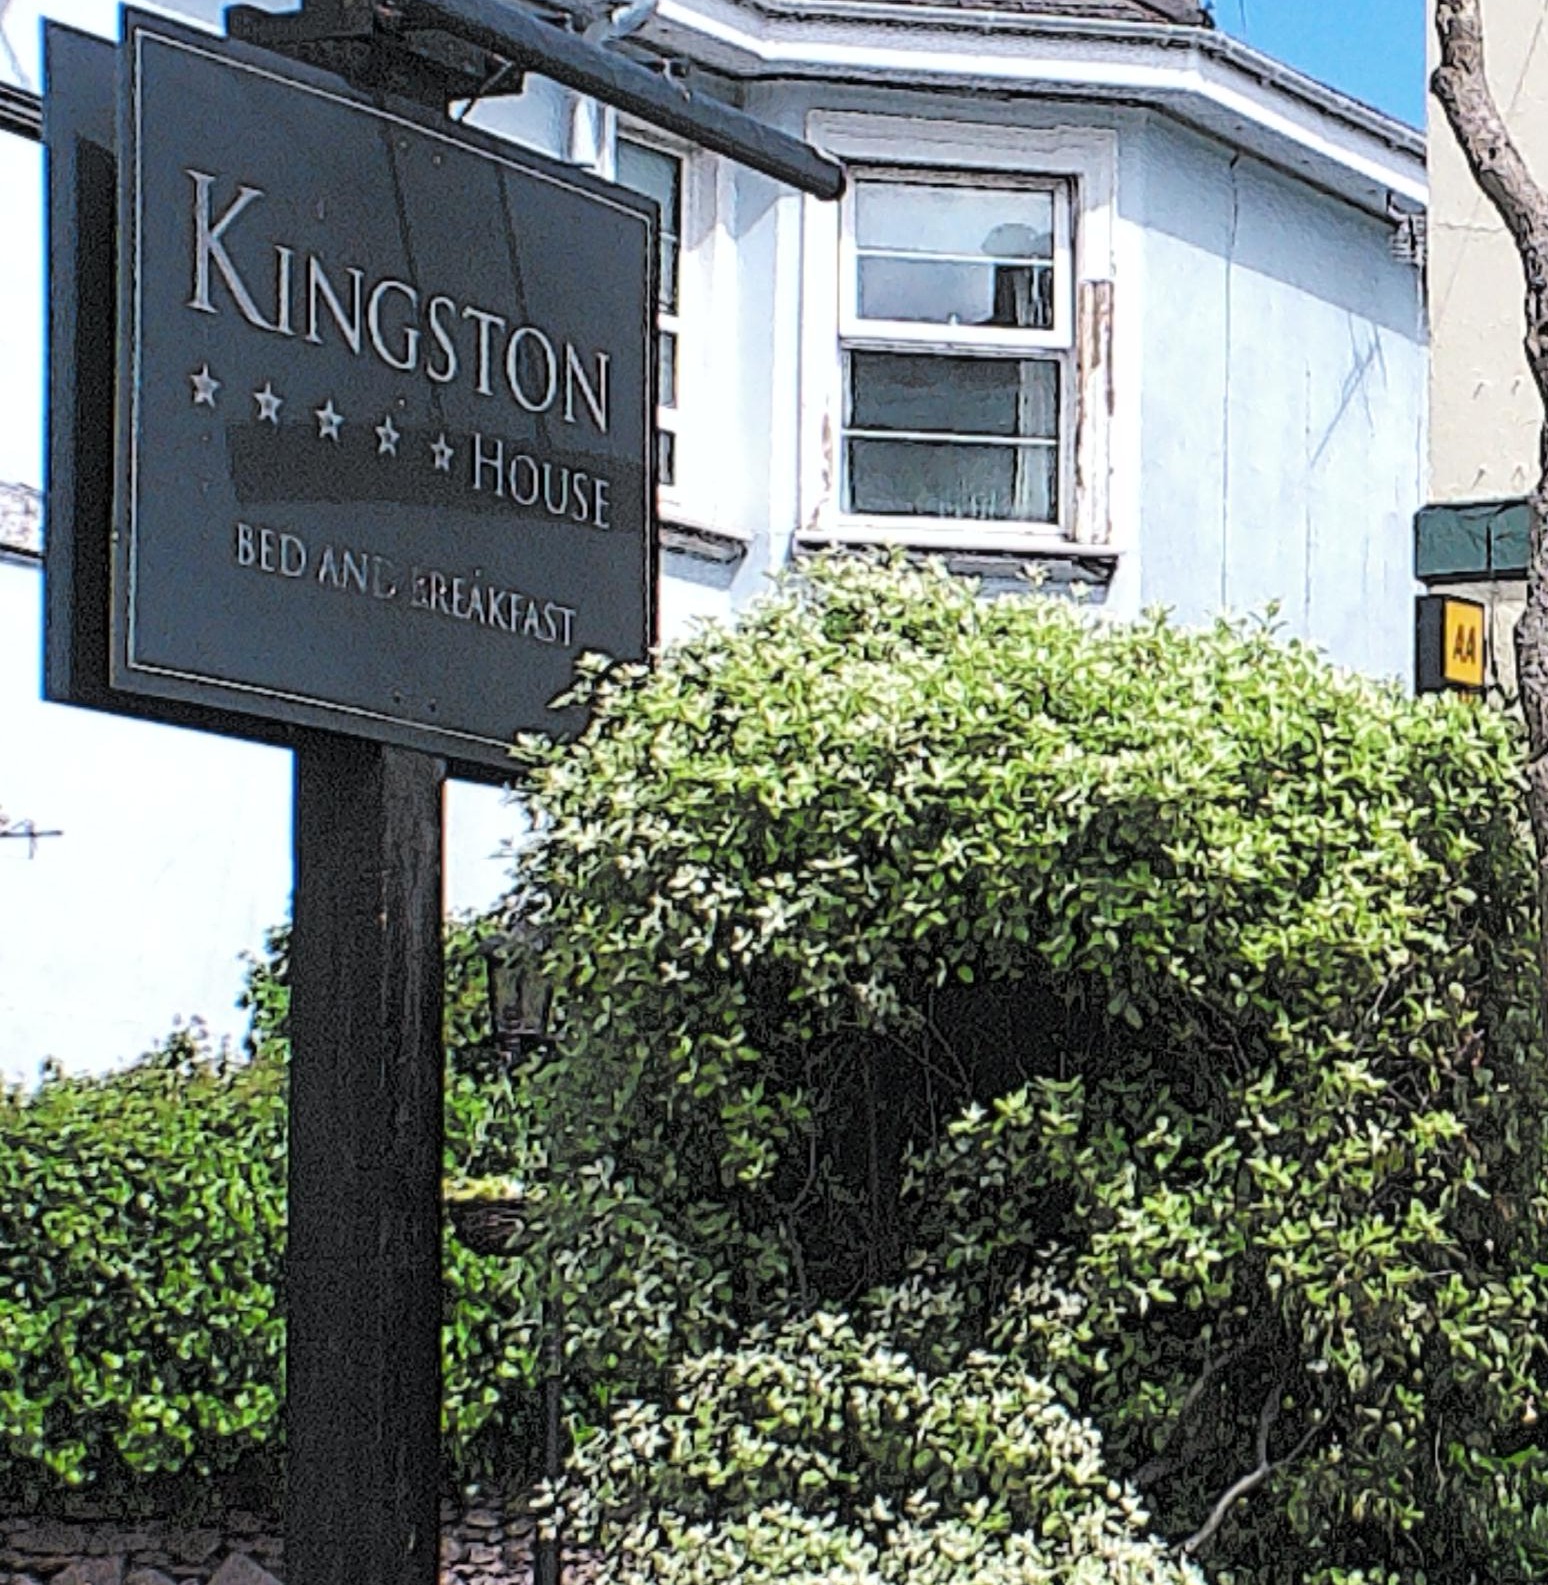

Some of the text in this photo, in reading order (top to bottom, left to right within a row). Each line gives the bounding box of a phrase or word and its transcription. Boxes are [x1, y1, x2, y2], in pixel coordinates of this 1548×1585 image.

[186, 168, 610, 433] KINGSTON
[470, 432, 611, 530] HOUSE
[236, 521, 308, 578] BED
[318, 545, 398, 601] AND
[1453, 623, 1477, 665] AA
